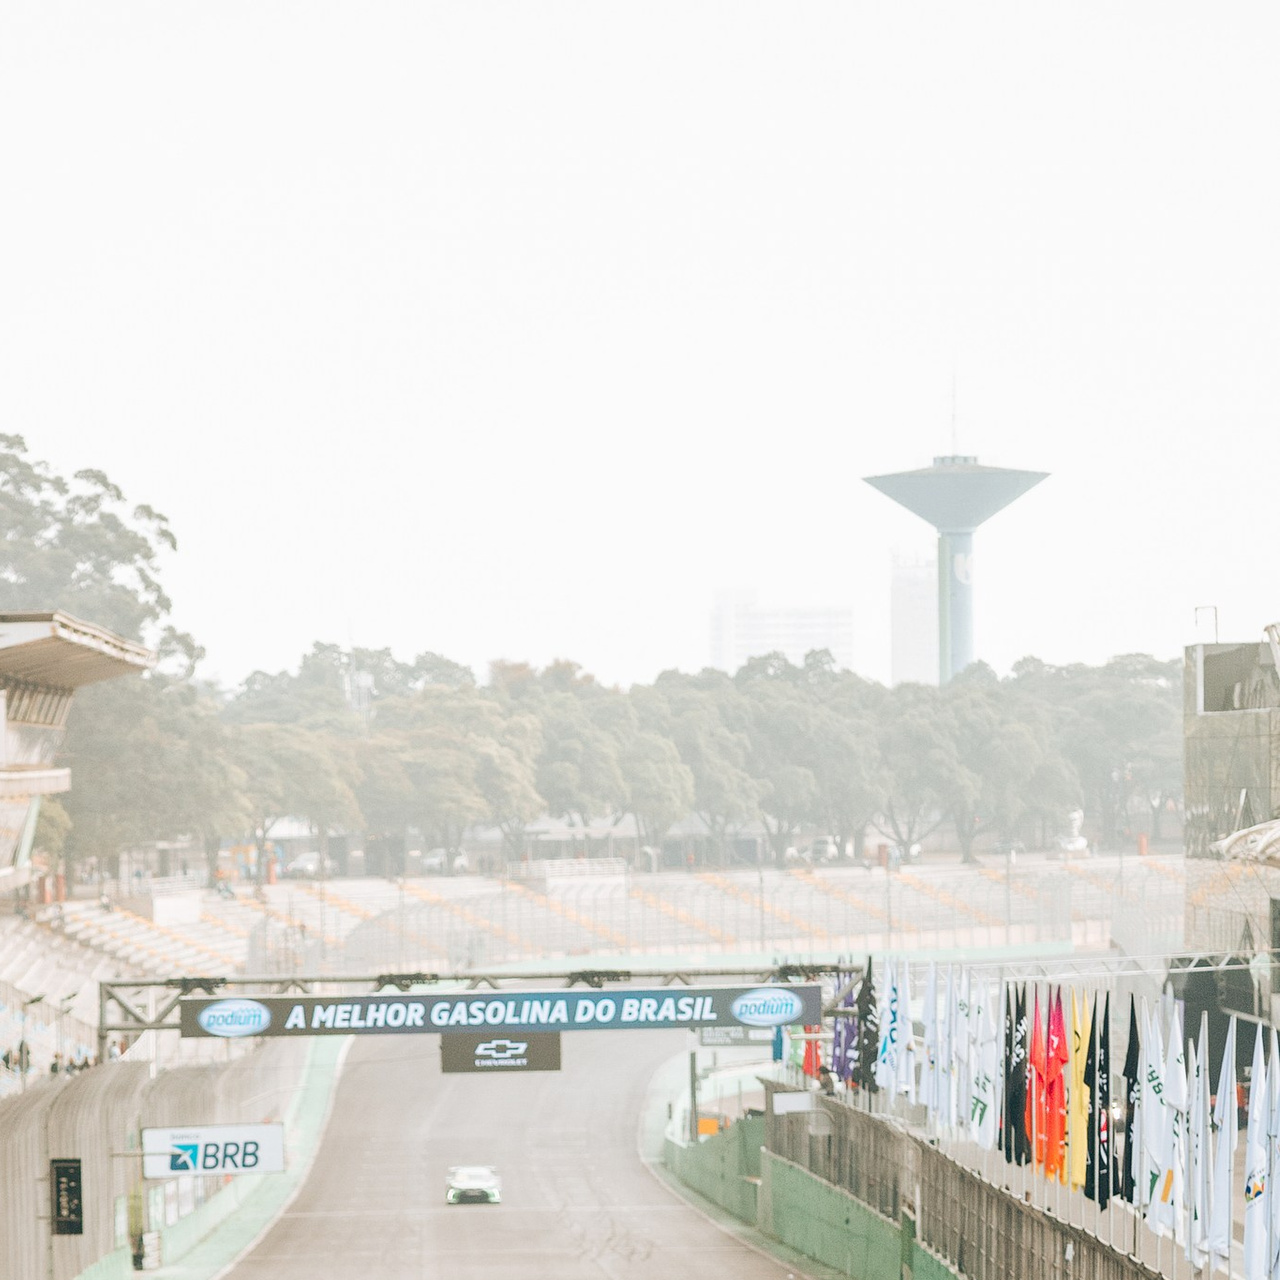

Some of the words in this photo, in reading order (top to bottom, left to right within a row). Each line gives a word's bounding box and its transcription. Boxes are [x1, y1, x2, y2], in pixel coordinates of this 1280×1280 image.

[207, 1009, 263, 1028] podium
[285, 1005, 307, 1030] A
[311, 1002, 425, 1029] MELHOR
[430, 1000, 569, 1026] GASOLINA
[574, 998, 617, 1023] DO
[621, 997, 718, 1022] BRASIL
[737, 999, 795, 1019] podium
[202, 1141, 260, 1170] BRB
